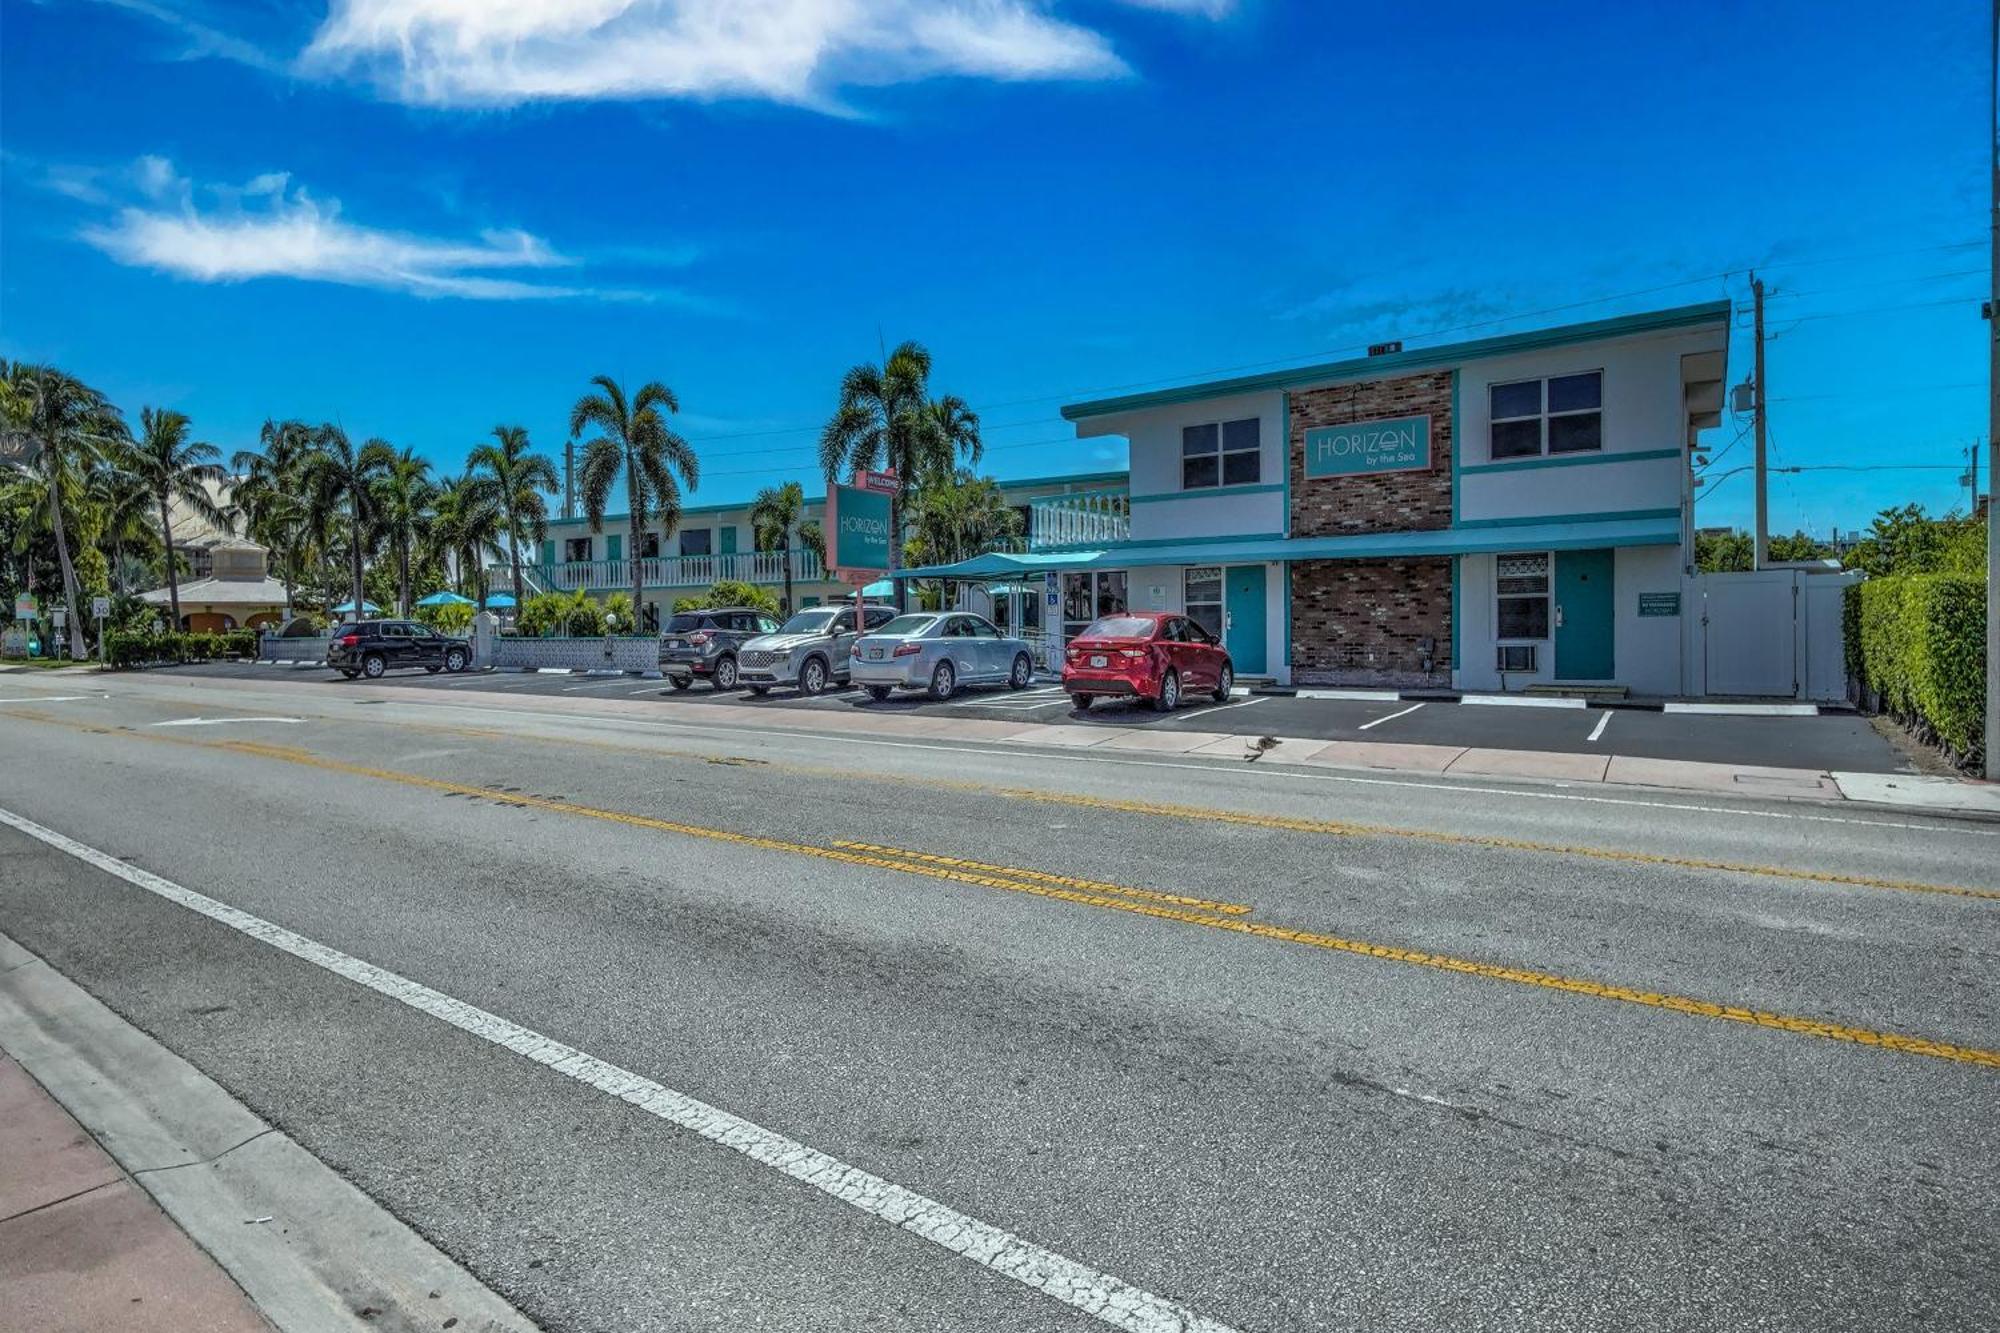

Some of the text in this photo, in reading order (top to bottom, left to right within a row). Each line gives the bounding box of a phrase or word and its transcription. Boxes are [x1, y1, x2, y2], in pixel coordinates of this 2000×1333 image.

[1318, 424, 1415, 462] HORIZON
[1366, 451, 1416, 466] by the Sea
[868, 475, 899, 488] WELCOME
[840, 516, 888, 535] HORIZON
